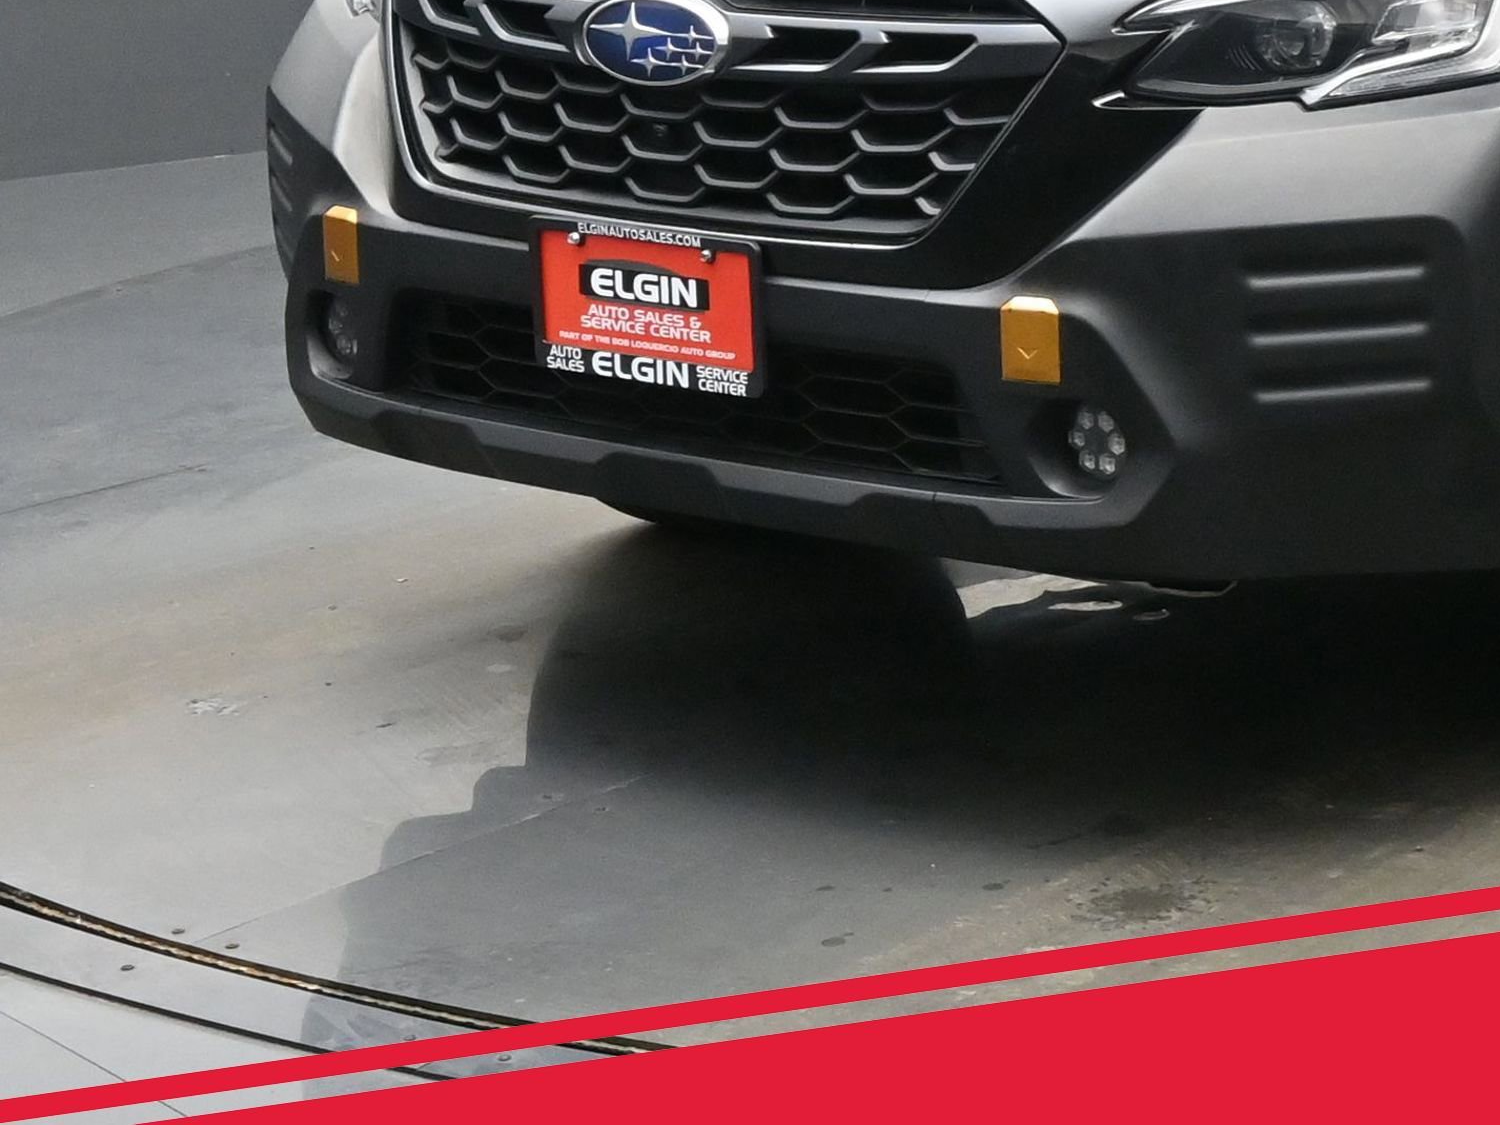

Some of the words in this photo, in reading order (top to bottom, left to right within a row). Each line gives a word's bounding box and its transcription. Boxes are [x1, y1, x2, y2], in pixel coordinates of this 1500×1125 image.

[578, 222, 701, 248] ELGINAUTOSALES.COM
[590, 268, 698, 308] ELGIN
[587, 304, 630, 319] AUTO
[634, 309, 684, 327] SALES
[689, 316, 702, 329] &
[580, 315, 645, 335] SERVICE
[650, 324, 712, 344] CENTER
[549, 344, 582, 359] AUTO
[546, 356, 585, 373] SALES
[591, 351, 690, 389] ELGIN
[696, 365, 748, 385] SERVICE
[698, 378, 747, 397] CENTER
